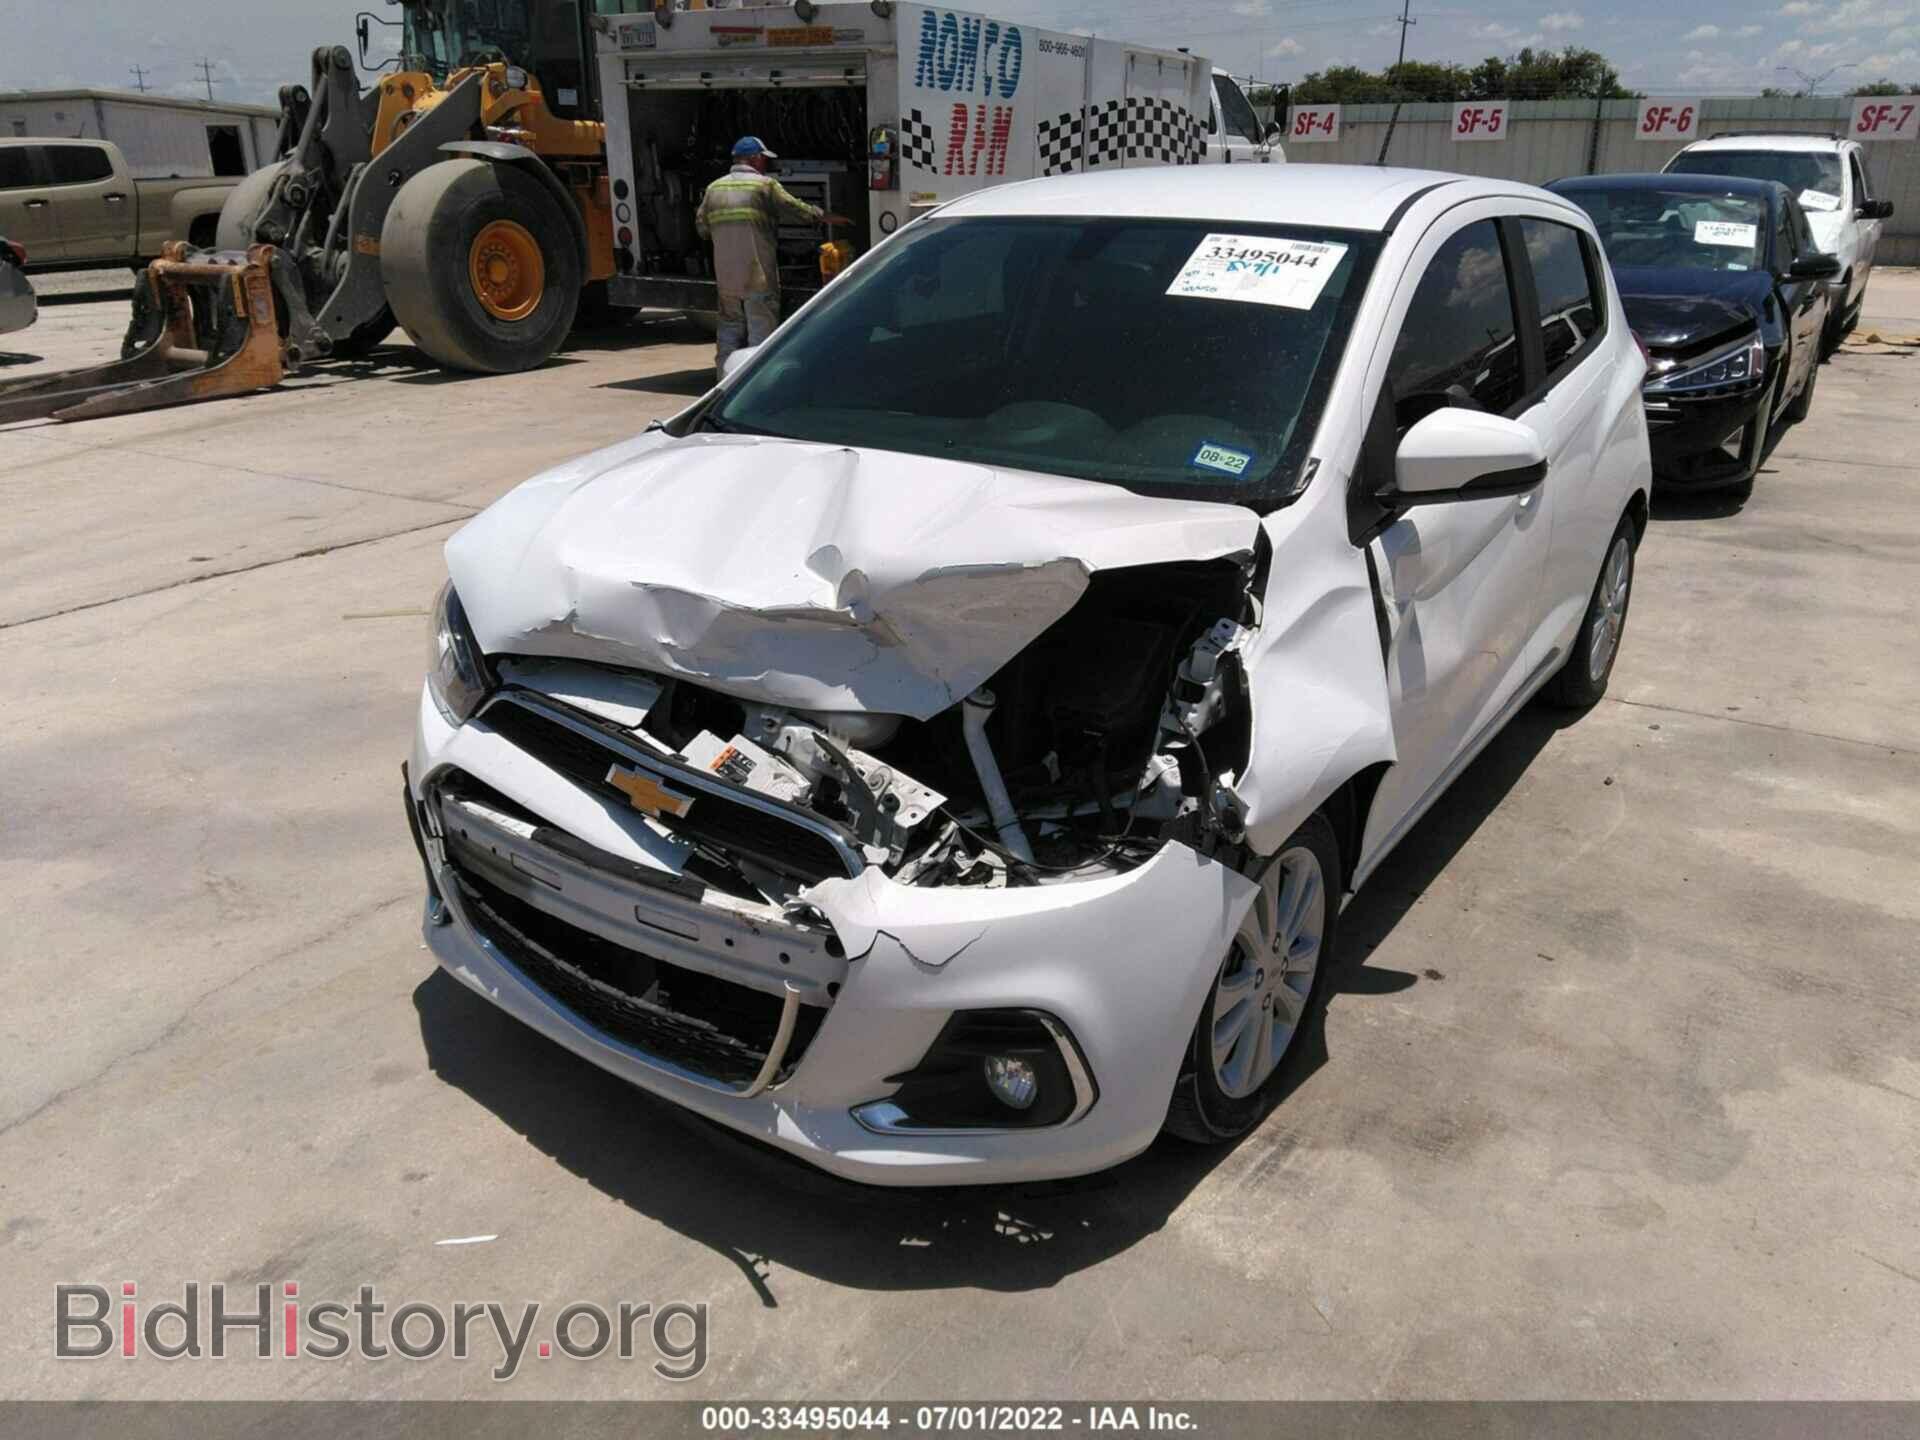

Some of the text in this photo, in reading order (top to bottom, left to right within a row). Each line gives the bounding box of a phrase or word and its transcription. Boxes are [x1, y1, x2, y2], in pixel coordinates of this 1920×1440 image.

[914, 10, 1022, 99] ROMCO
[1295, 112, 1335, 135] SF-4
[1457, 108, 1503, 133] SF-5
[1642, 106, 1693, 133] SF-6
[1857, 105, 1914, 132] SF-7
[943, 102, 1013, 176] RPM
[1205, 246, 1319, 268] 33495044
